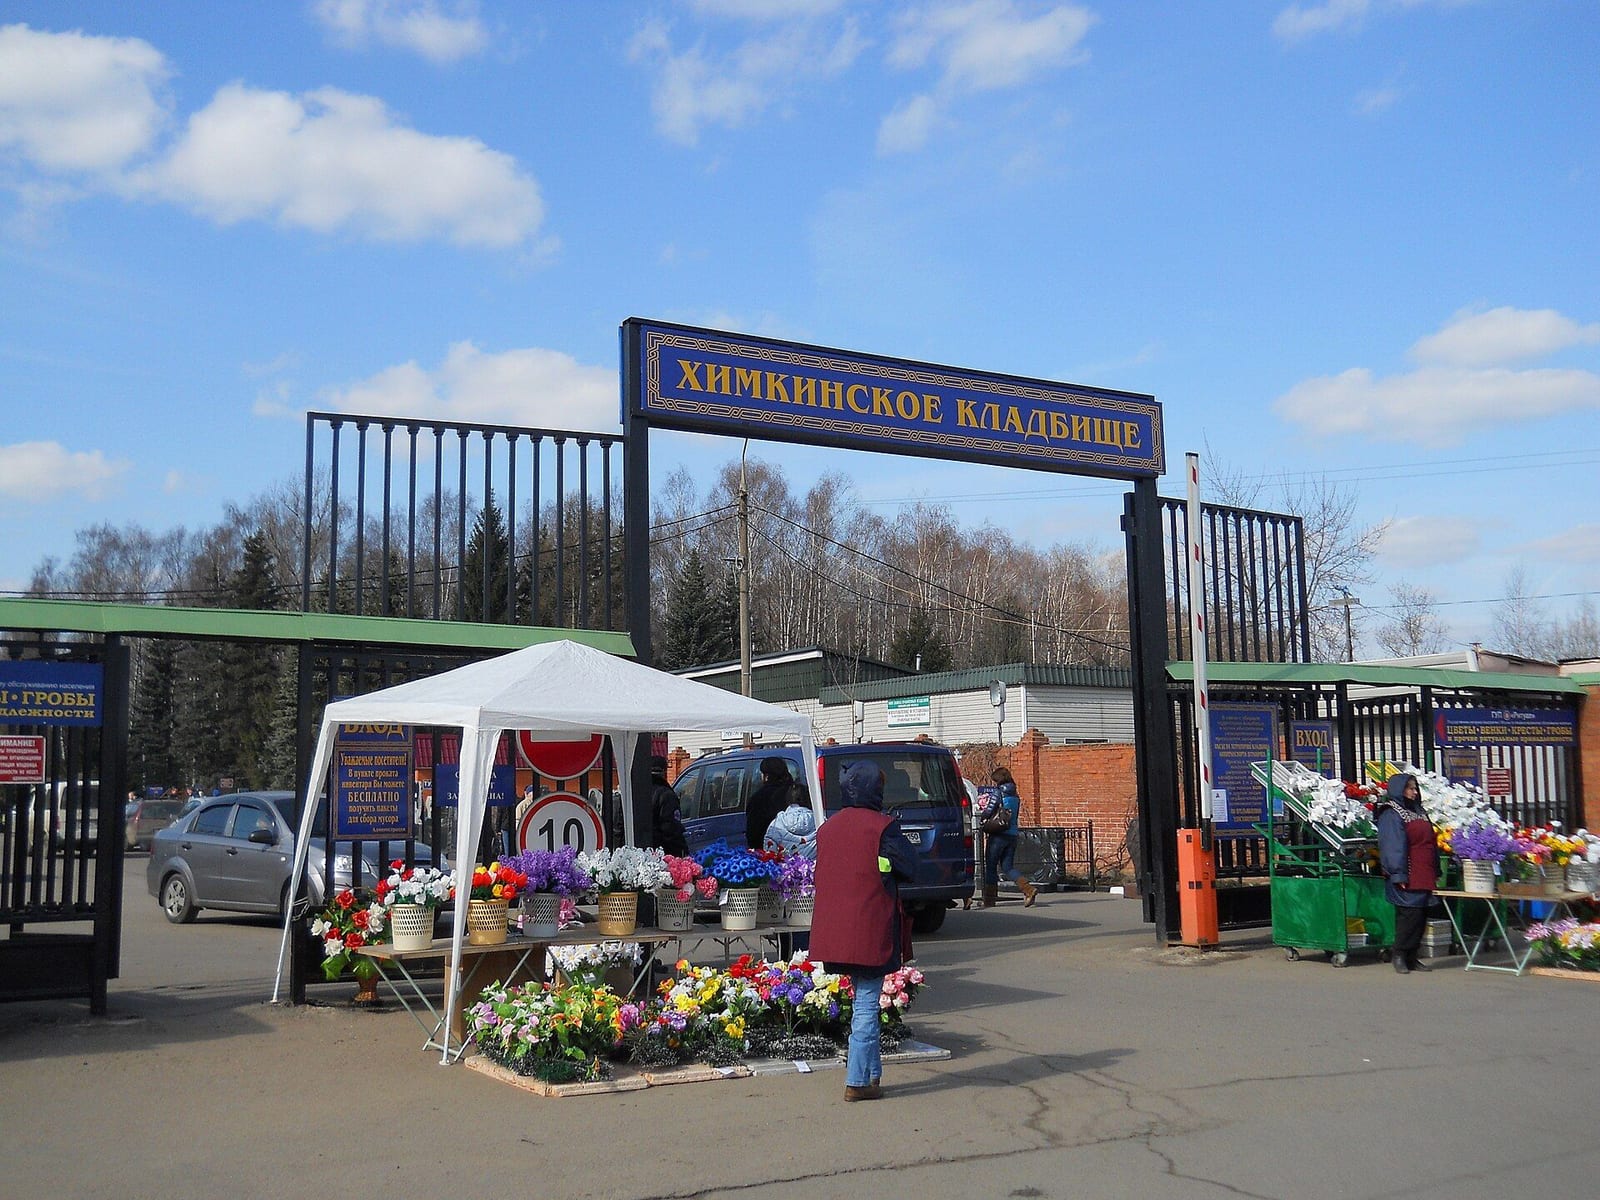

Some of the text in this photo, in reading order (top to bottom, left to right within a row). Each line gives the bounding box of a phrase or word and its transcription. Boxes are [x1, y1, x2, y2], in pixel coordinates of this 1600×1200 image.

[675, 358, 1142, 449] ХИМКИНСКОЕ КЛАДБИЩЕ
[22, 691, 95, 707] ГРОБЫ
[0, 739, 36, 747] ИМАНИЕ!
[1295, 729, 1330, 749] ВХОД
[348, 791, 400, 802] БЕСПЛАТНО
[538, 818, 585, 856] 10
